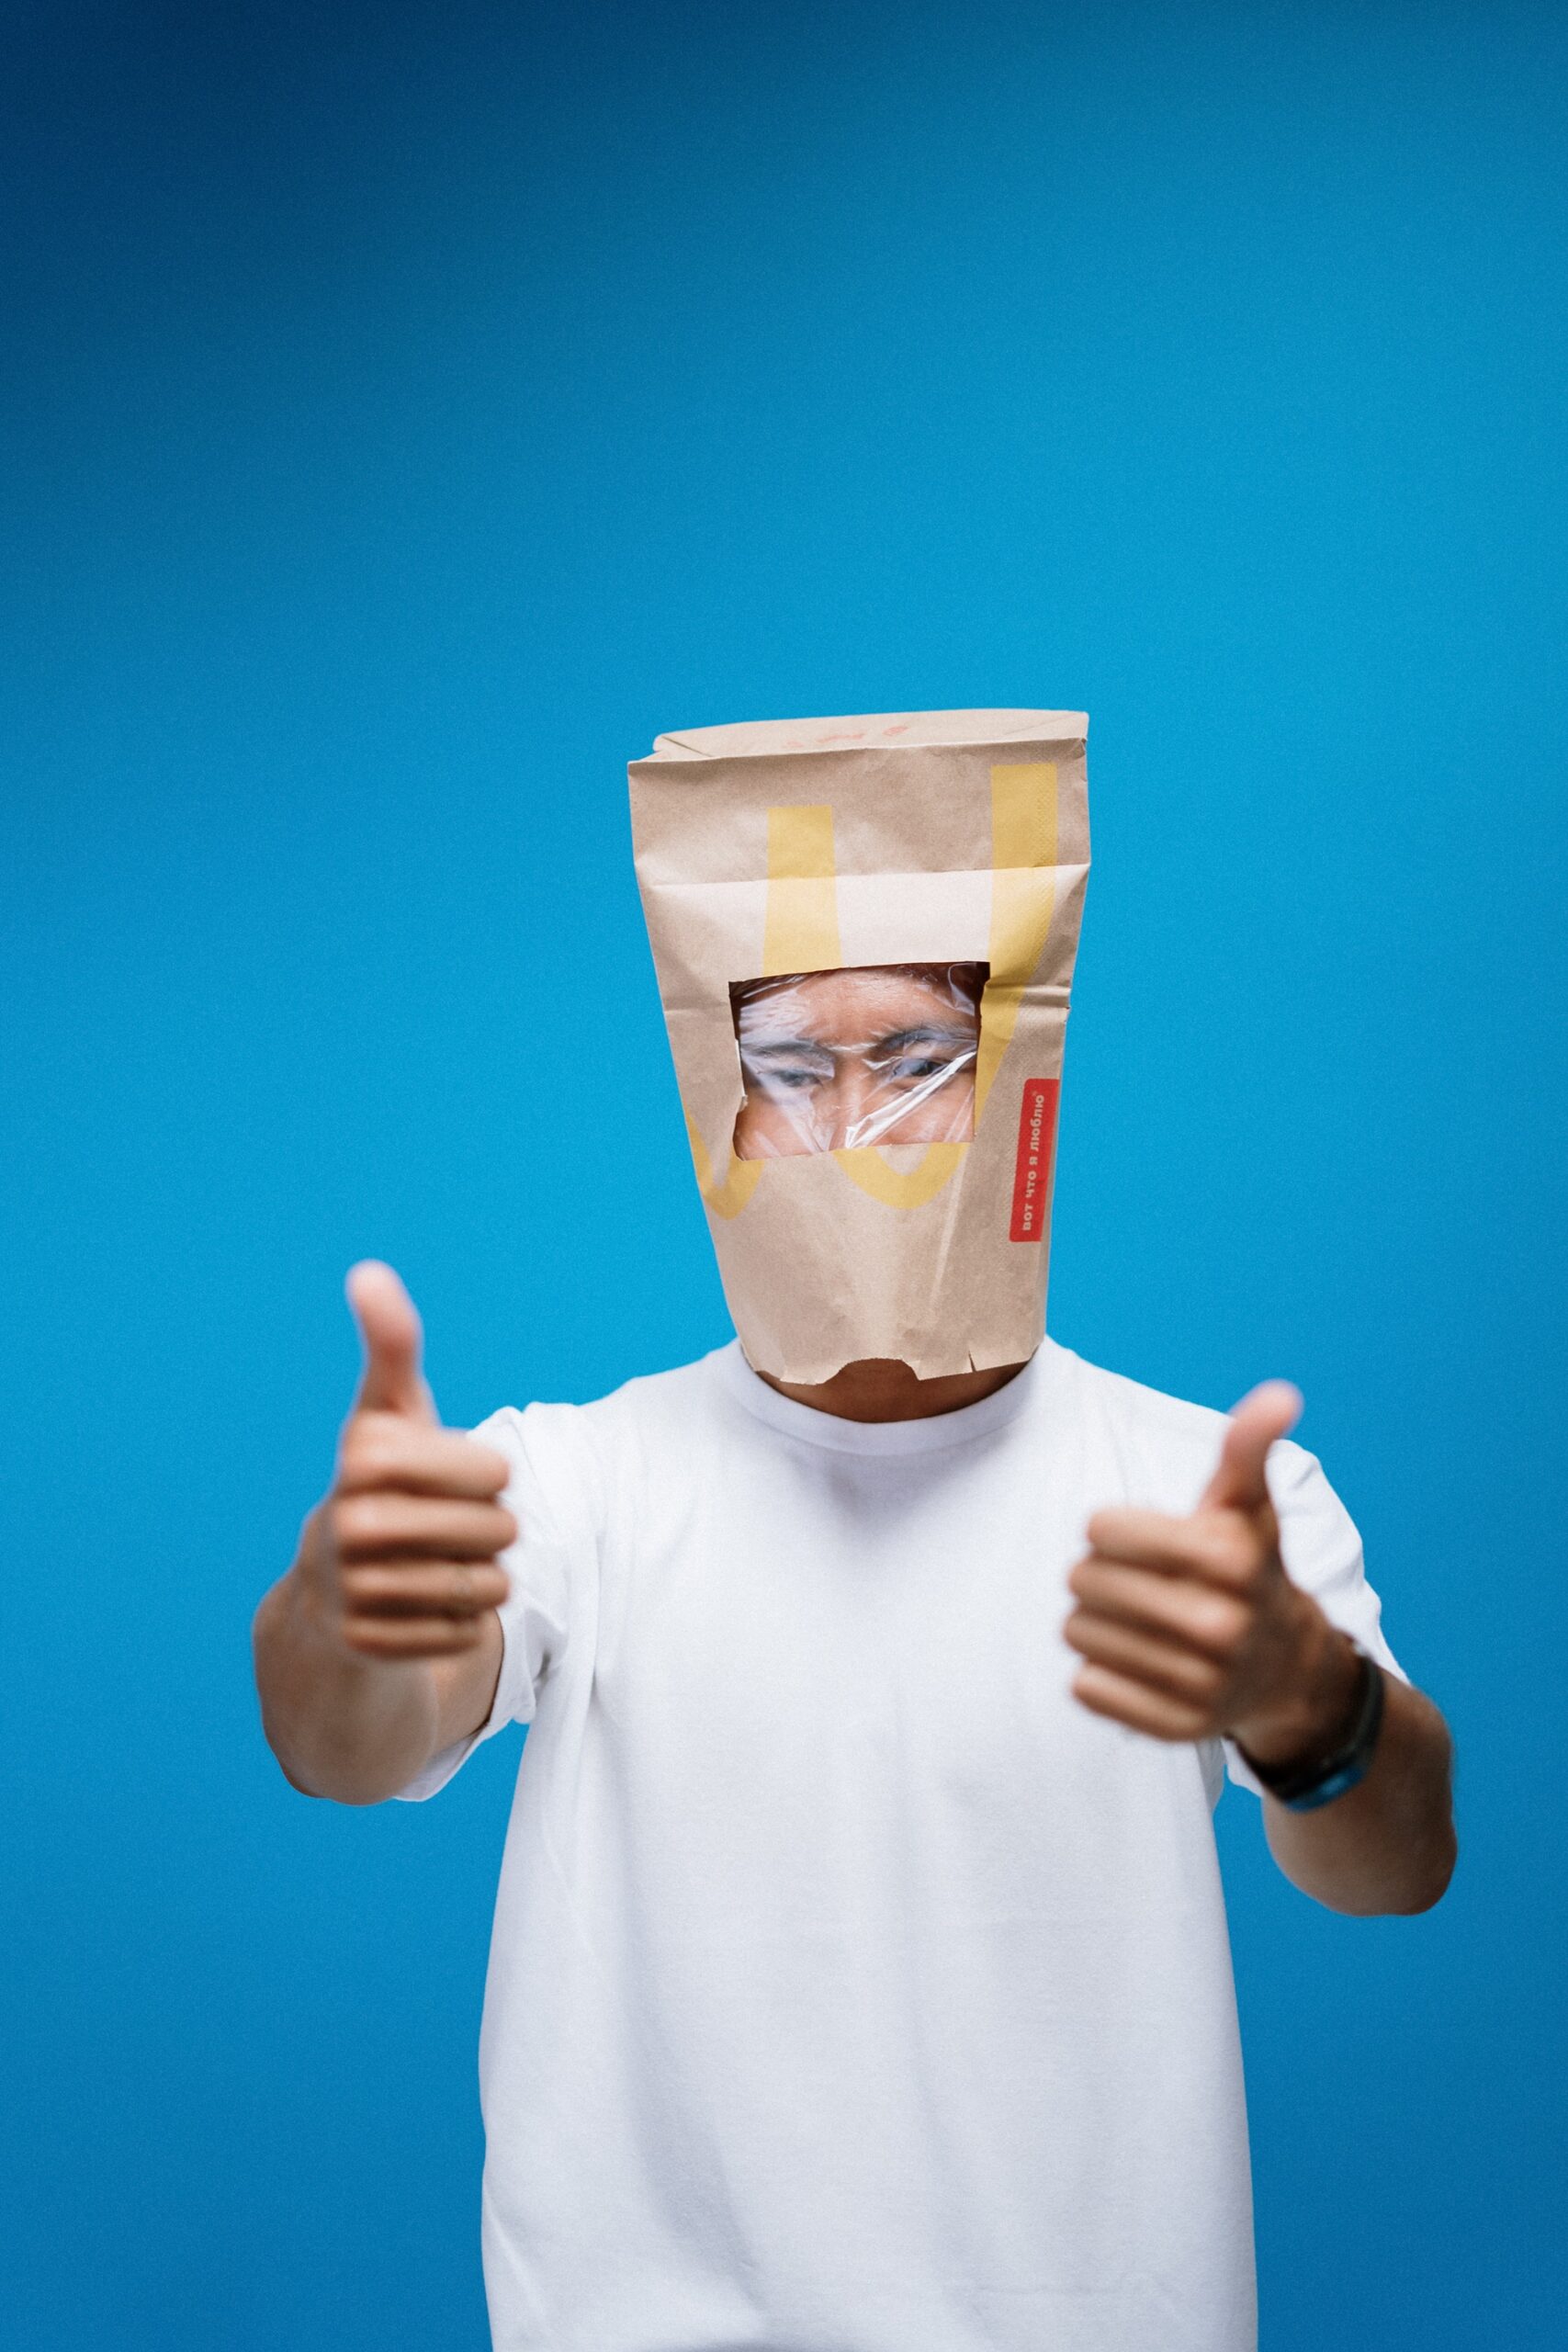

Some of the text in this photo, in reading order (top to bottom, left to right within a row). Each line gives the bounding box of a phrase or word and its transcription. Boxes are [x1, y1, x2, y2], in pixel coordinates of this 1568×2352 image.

[1022, 1094, 1044, 1231] вот что я люблю
